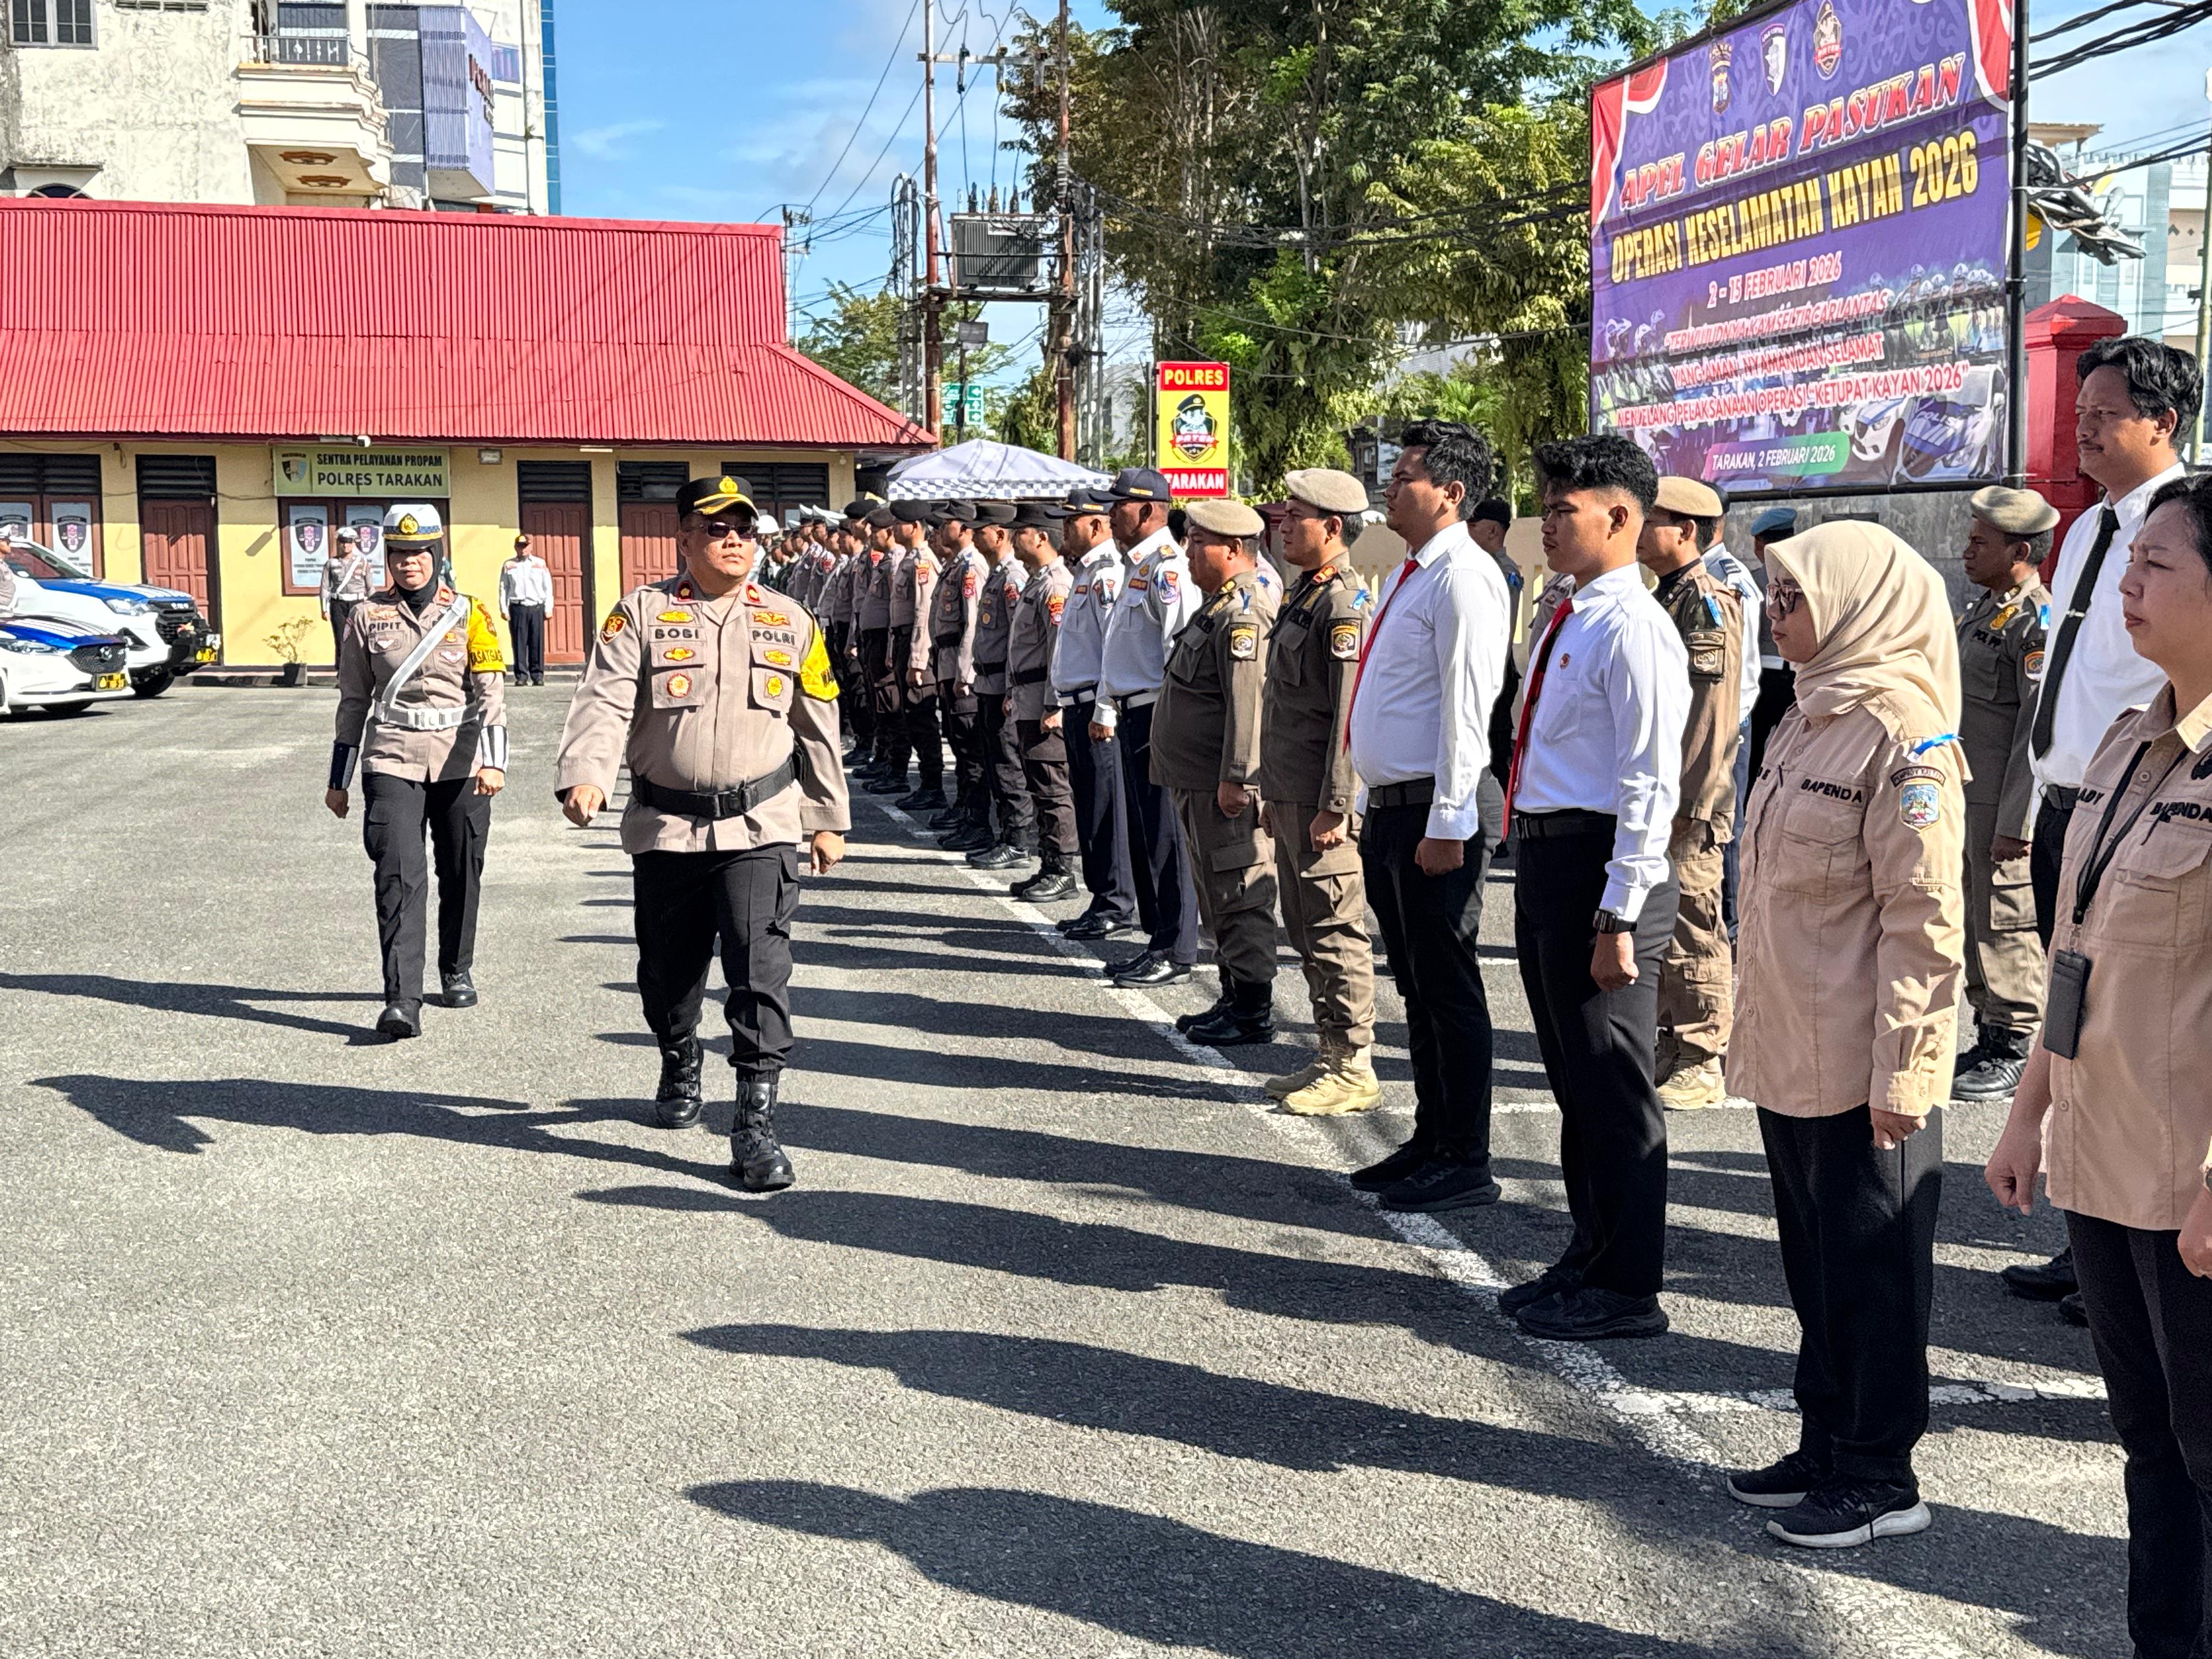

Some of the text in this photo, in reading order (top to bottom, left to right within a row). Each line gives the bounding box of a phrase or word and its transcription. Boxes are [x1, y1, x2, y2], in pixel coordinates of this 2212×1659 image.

[1620, 52, 1966, 212] APEL GELAR PASUKAN
[1611, 131, 1979, 283] OPERASI KESELAMATAN KAYAN 2026
[1707, 281, 1717, 308] 2
[1728, 276, 1742, 304] 15
[1745, 261, 1807, 301] FEBRUARI
[1808, 251, 1842, 286] 2026
[1670, 362, 1703, 388] YANG
[1797, 343, 1826, 373] DAN
[1825, 331, 1885, 366] SELAMAT
[1164, 369, 1224, 385] POLRES
[1675, 390, 1756, 426] PELAKSANAAN
[1756, 383, 1807, 415] OPERASI
[1870, 368, 1920, 402] KAYAN
[317, 453, 351, 465] SENTRA
[354, 454, 402, 466] PELAYANAN
[405, 455, 442, 466] PROPAM
[1712, 444, 1835, 472] TARAKAN, 2 FEBRUARI 2026
[318, 472, 443, 487] POLRES TARAKAN
[1164, 473, 1224, 489] TARAKAN
[369, 622, 401, 632] PIPIT
[752, 630, 795, 645] POLRI
[1801, 779, 1862, 804] BAPENDA
